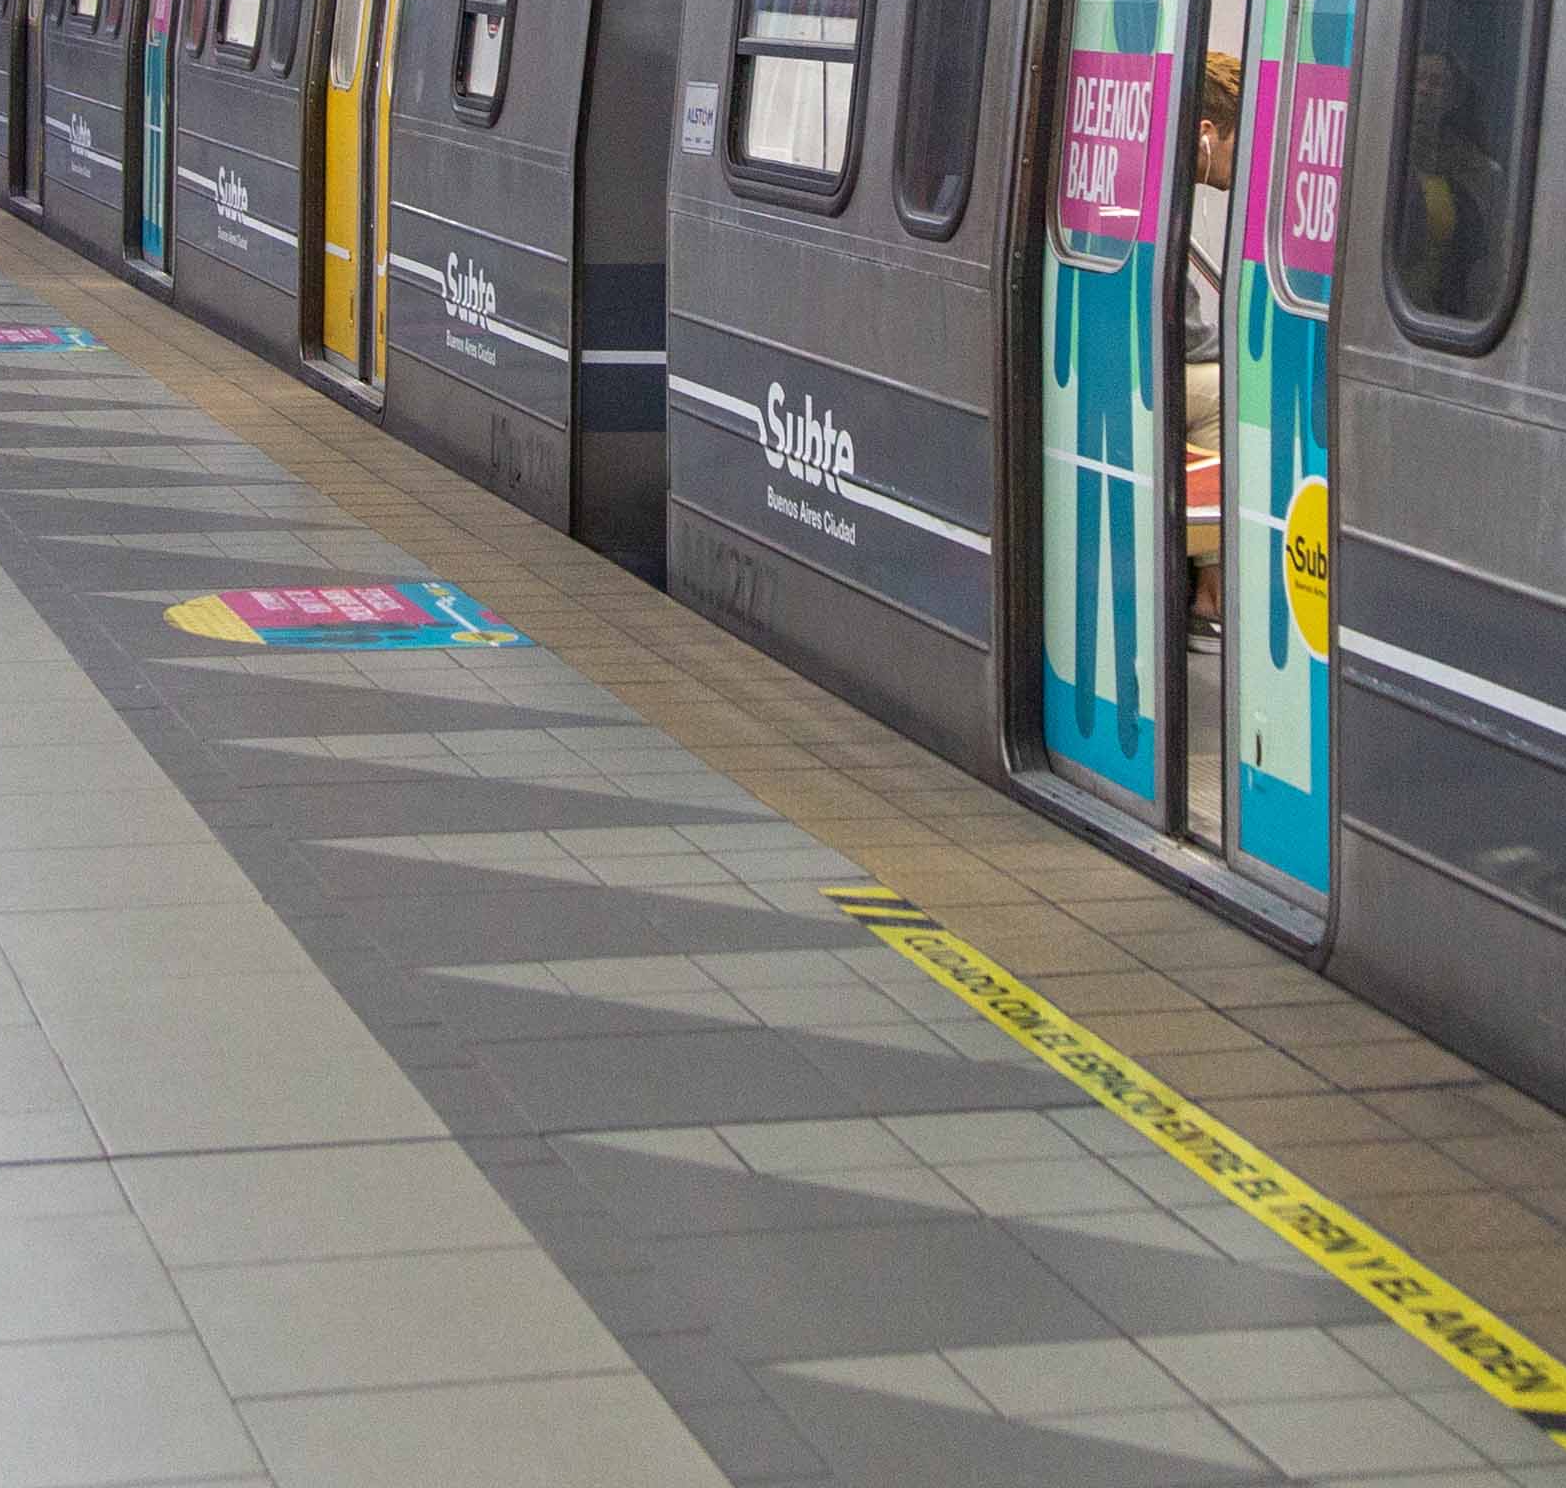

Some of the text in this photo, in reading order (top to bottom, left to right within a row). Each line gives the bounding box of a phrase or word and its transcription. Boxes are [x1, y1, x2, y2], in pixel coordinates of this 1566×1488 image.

[1072, 76, 1151, 143] DEJEMOS
[216, 165, 248, 224] Subte
[1066, 139, 1118, 205] BAJAR
[1293, 171, 1338, 242] SUB
[444, 252, 496, 332] Subte
[764, 381, 854, 497] Subte
[767, 485, 856, 545] Buenos Aires Ciudad
[905, 935, 1009, 995] CUIDADO
[989, 998, 1050, 1031] CON
